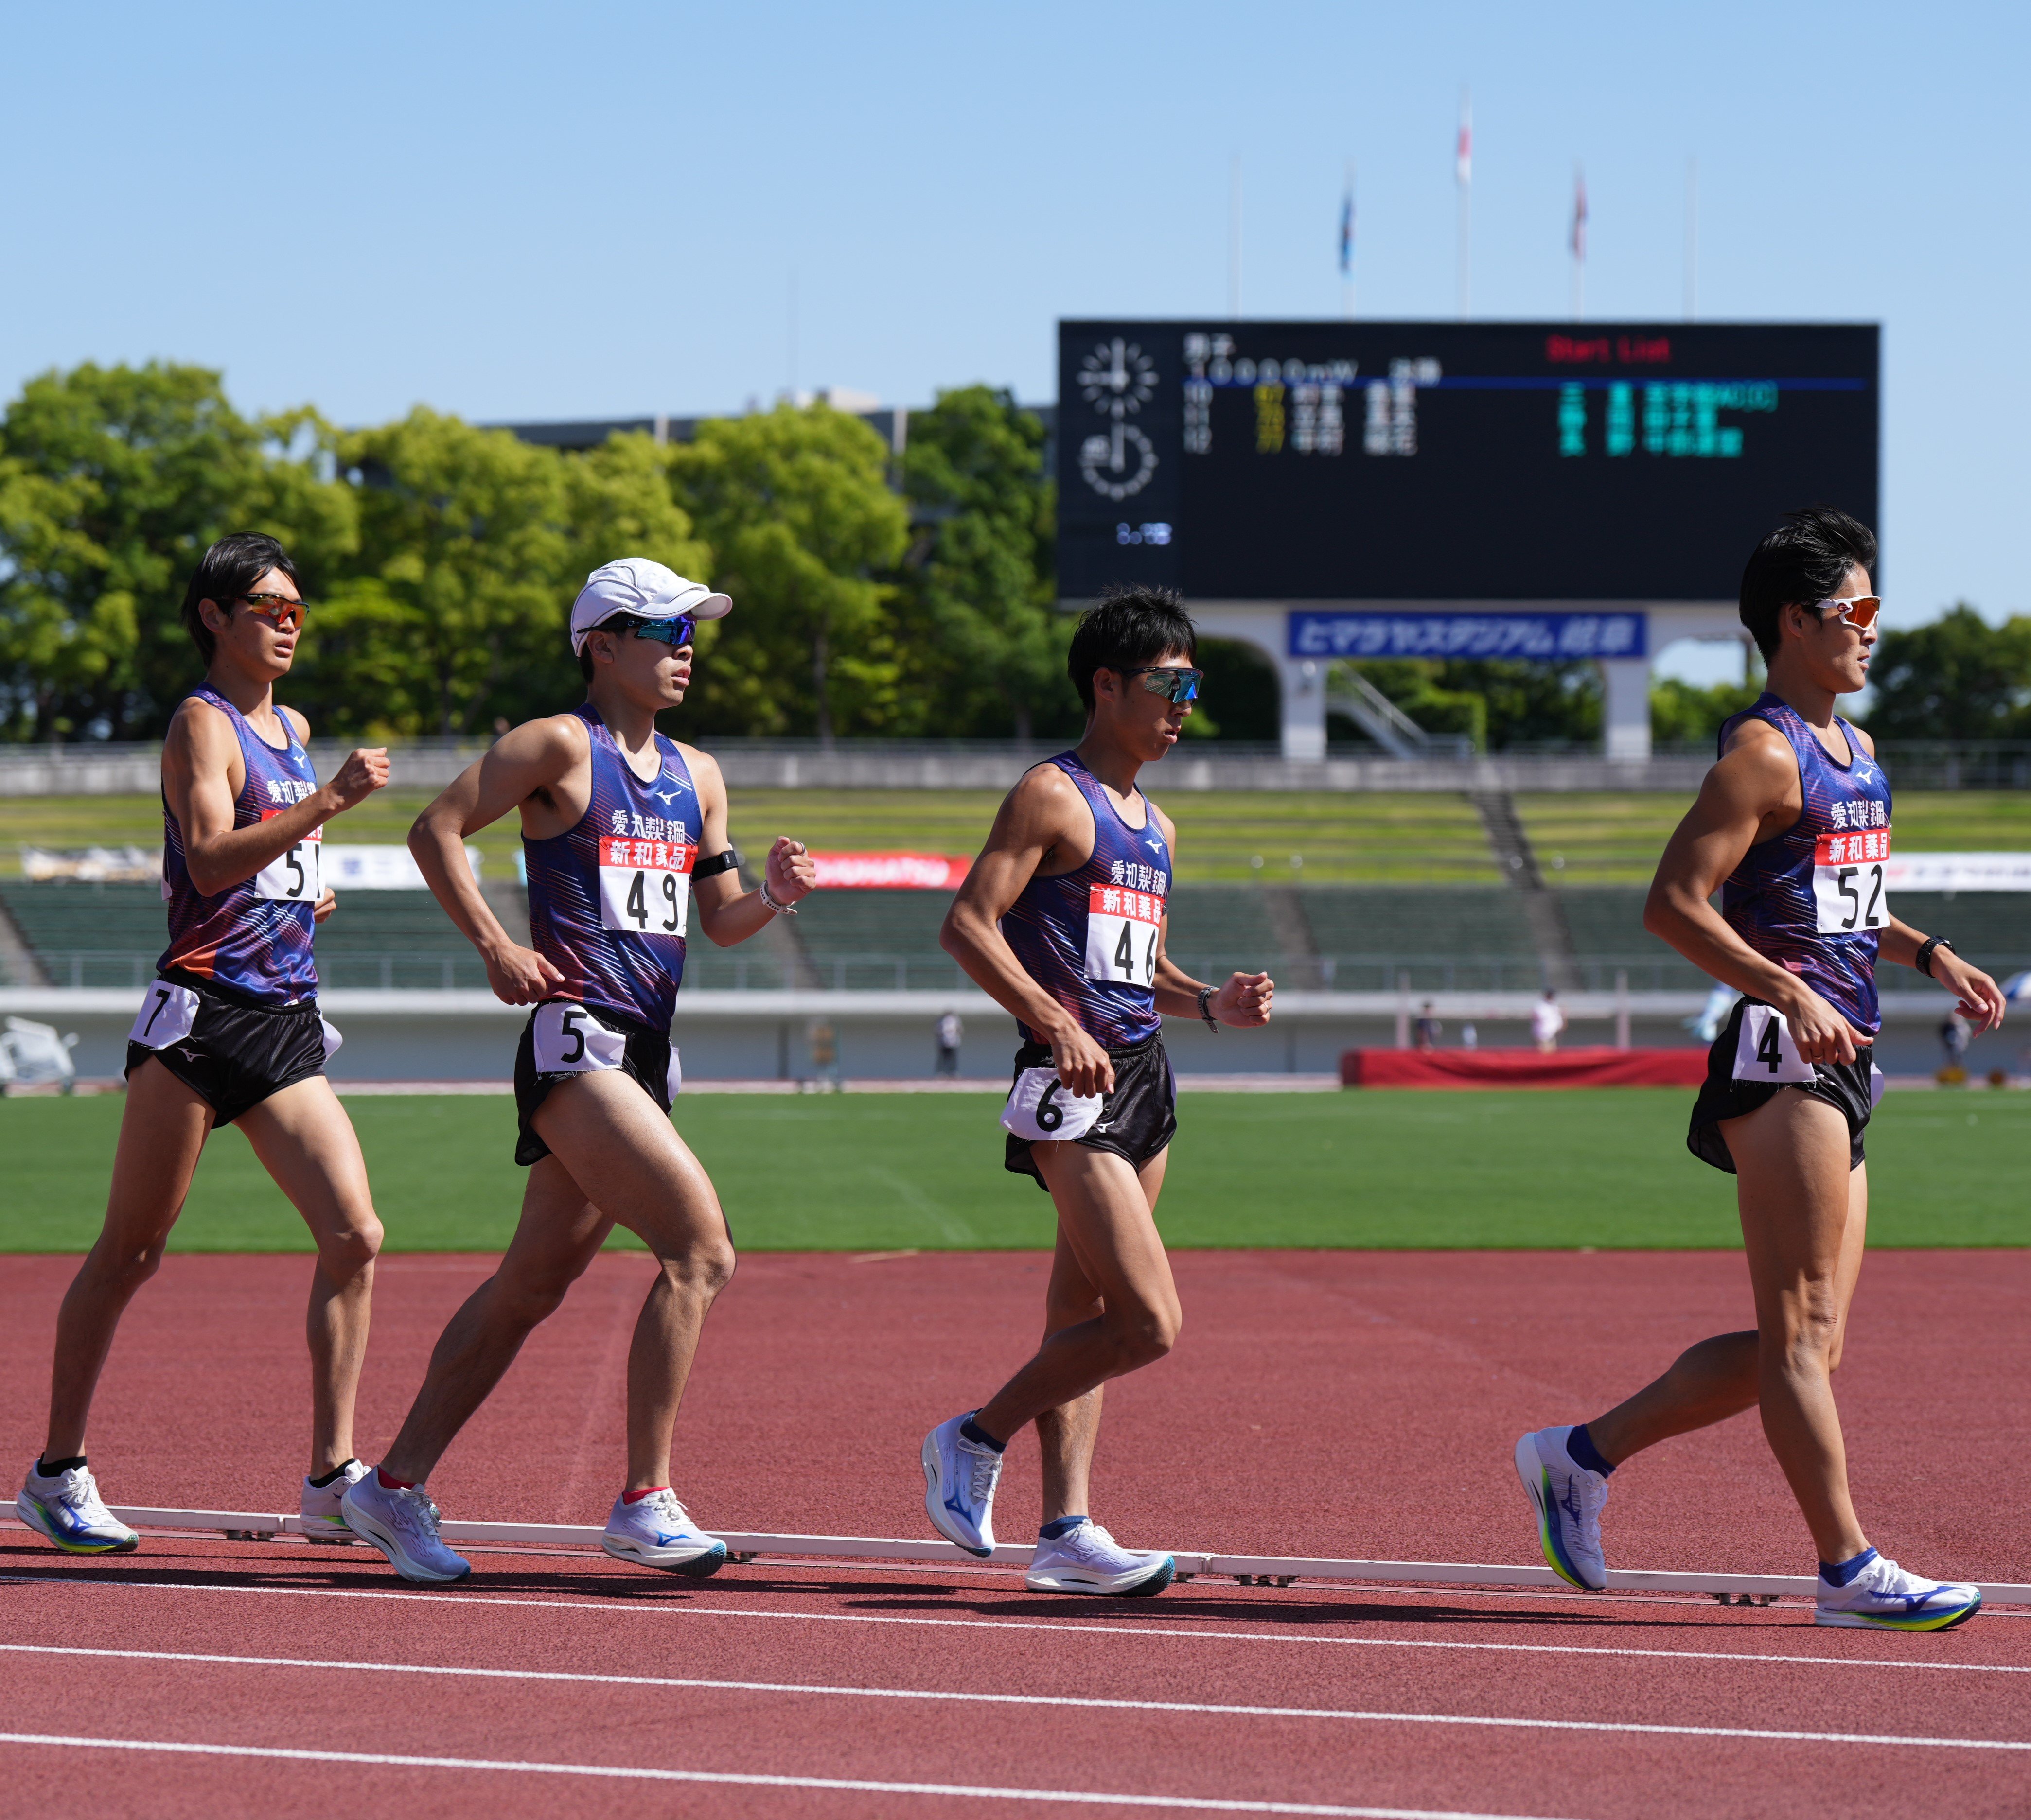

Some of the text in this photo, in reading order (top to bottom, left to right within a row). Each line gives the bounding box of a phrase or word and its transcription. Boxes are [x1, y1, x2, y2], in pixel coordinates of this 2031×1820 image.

[1831, 800, 1885, 829] 愛知製鋼
[1828, 832, 1887, 863] 新和薬品
[627, 870, 678, 932] 49
[1110, 860, 1166, 897] 愛知製鋼
[1838, 864, 1882, 929] 52
[1103, 888, 1161, 924] 新和薬品
[1114, 920, 1156, 985] 46
[143, 989, 170, 1037] 7
[561, 1011, 588, 1063] 5
[1756, 1016, 1782, 1073] 4
[1036, 1078, 1063, 1132] 6
